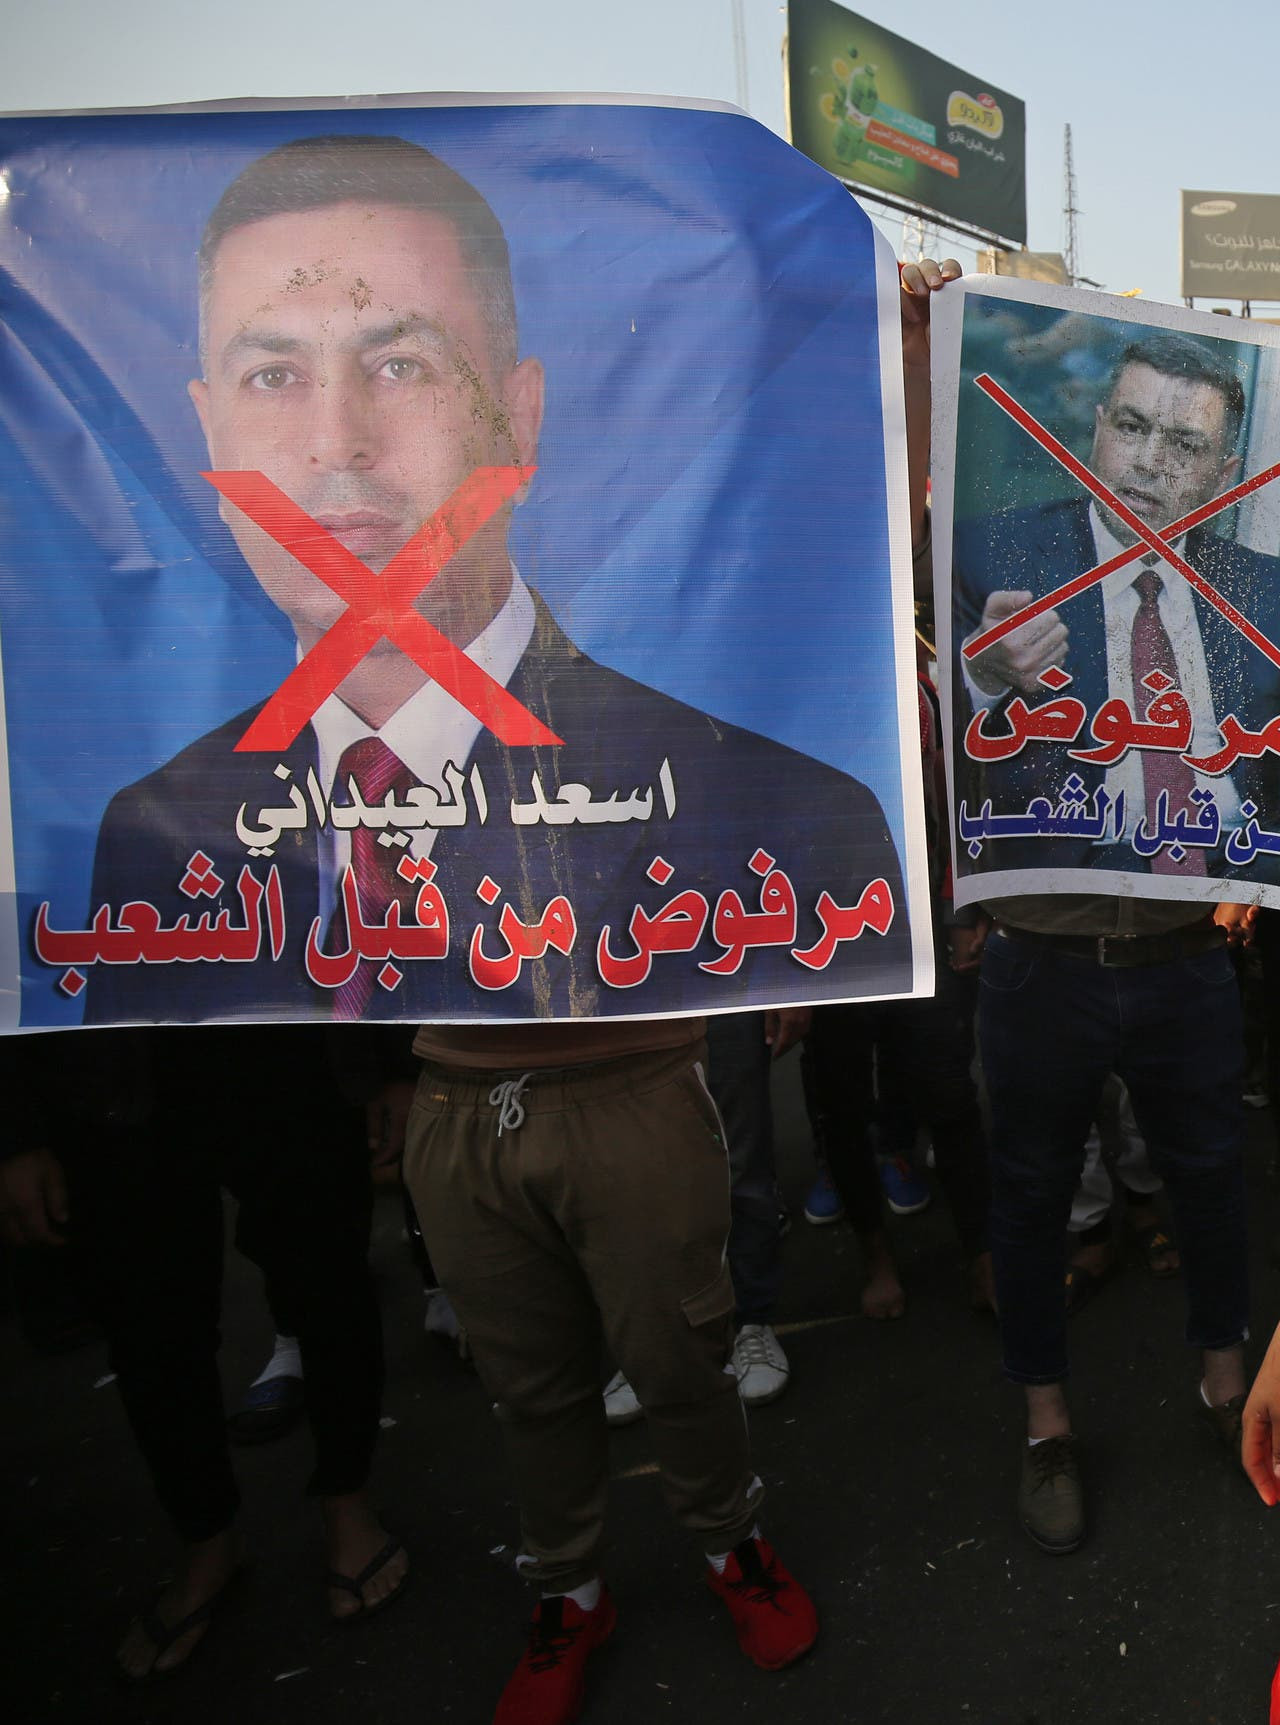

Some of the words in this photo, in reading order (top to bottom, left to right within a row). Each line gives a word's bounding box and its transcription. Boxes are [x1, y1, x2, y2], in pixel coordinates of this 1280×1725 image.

[1225, 259, 1269, 273] GALAXY
[235, 761, 489, 858] العيداني
[509, 757, 676, 827] اسعد
[958, 772, 1127, 860] الشعب
[1131, 787, 1222, 863] قبل
[34, 849, 286, 999] الشعب
[304, 855, 450, 994] قبل
[469, 874, 576, 991] من
[598, 846, 896, 989] مرفوض
